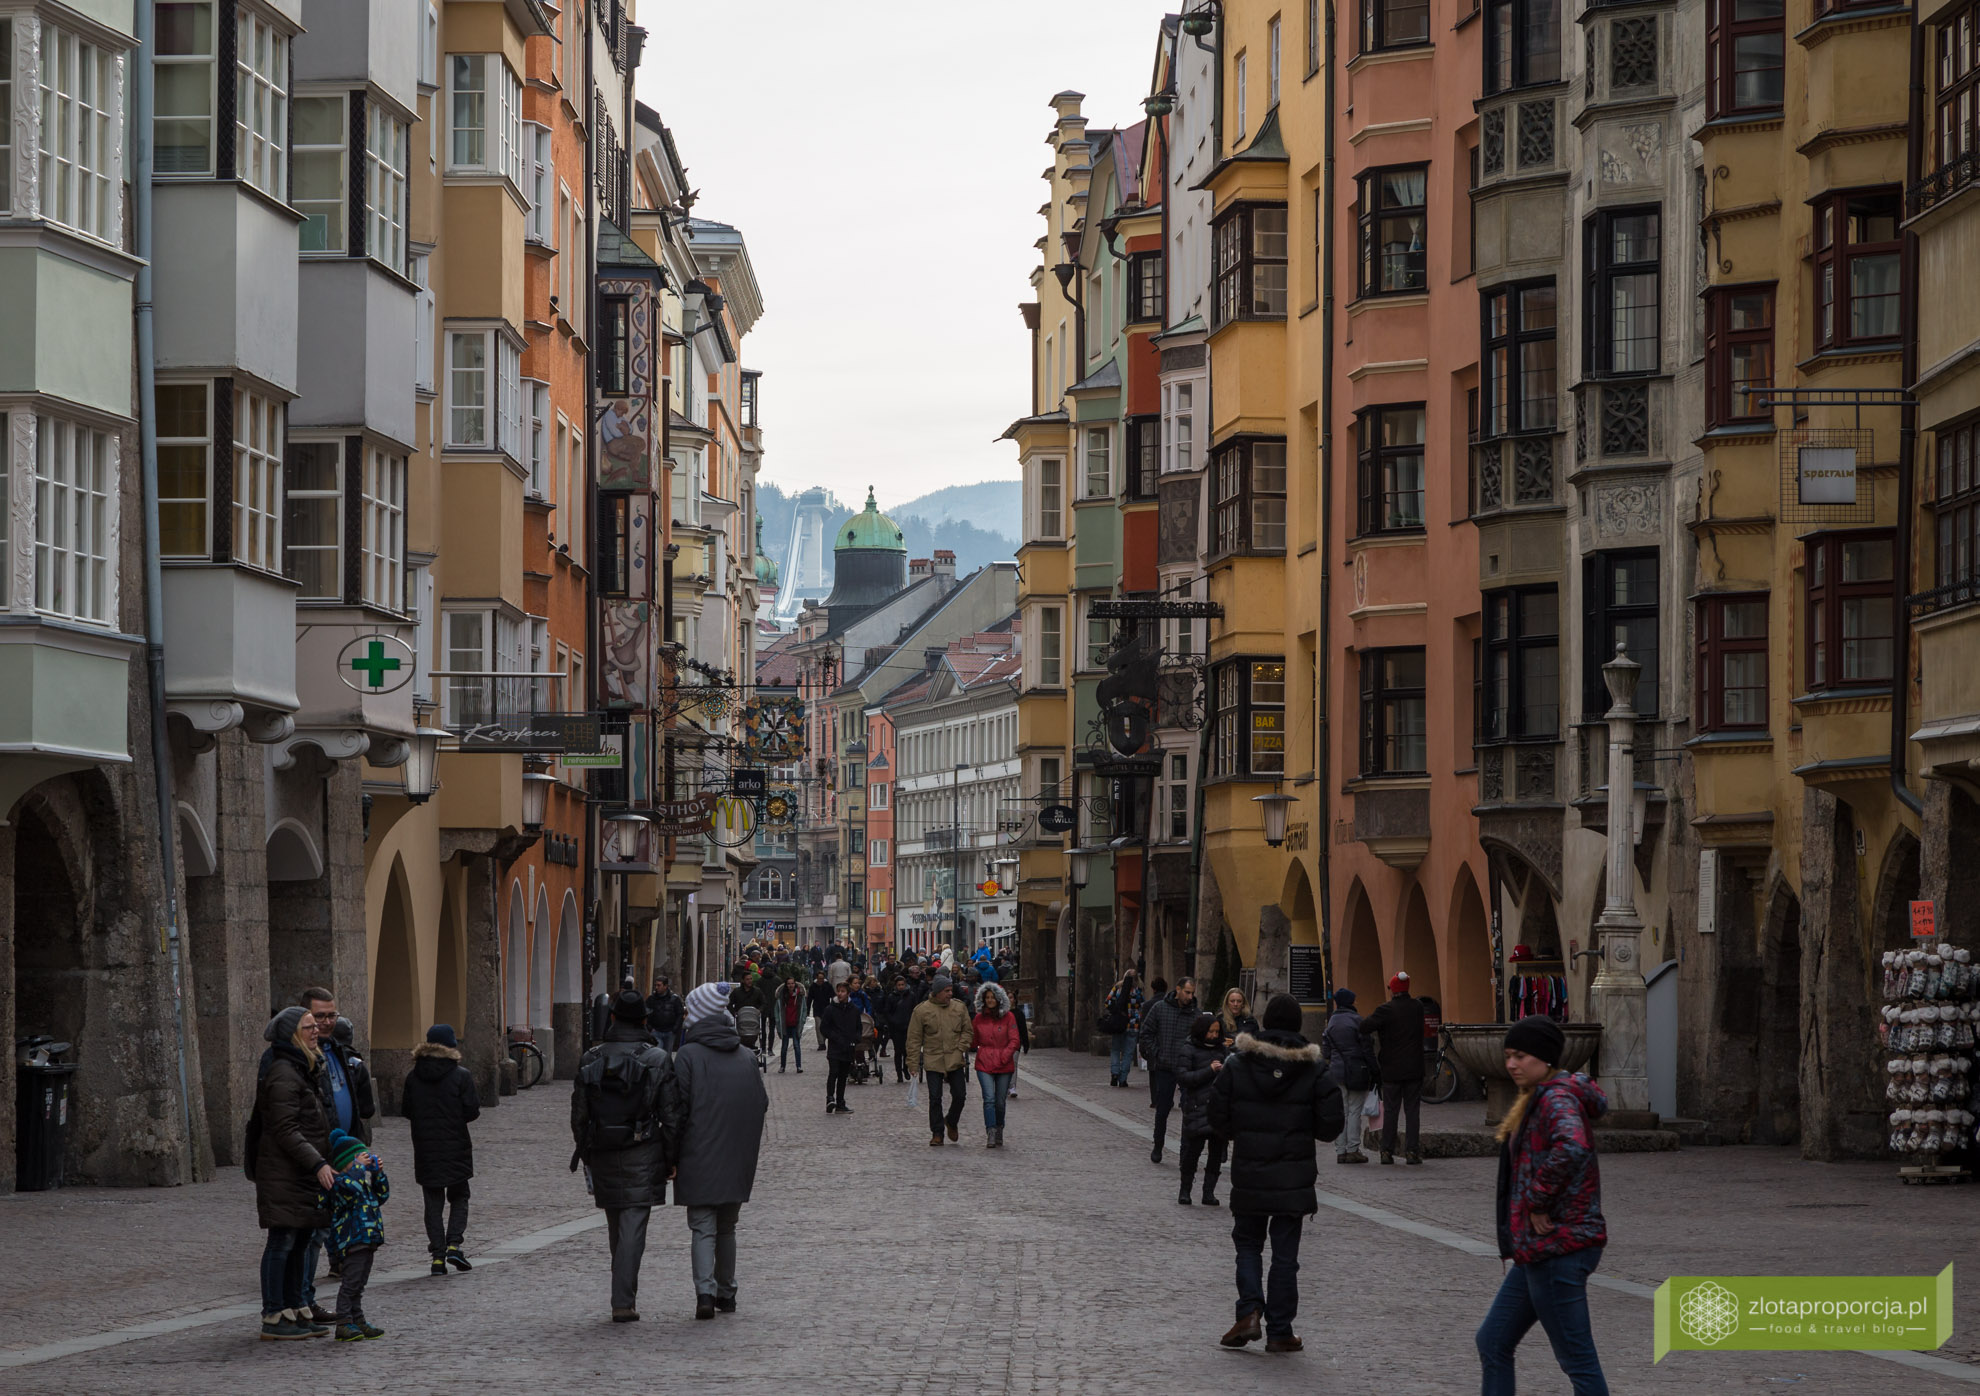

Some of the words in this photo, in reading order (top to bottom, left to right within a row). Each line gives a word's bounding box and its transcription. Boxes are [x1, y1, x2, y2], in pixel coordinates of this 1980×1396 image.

[1255, 716, 1275, 728] BAR
[463, 722, 560, 743] Kapferer
[1254, 736, 1282, 749] PIZZA
[567, 757, 617, 765] reformstark
[738, 778, 761, 789] arko
[998, 821, 1022, 832] FFP
